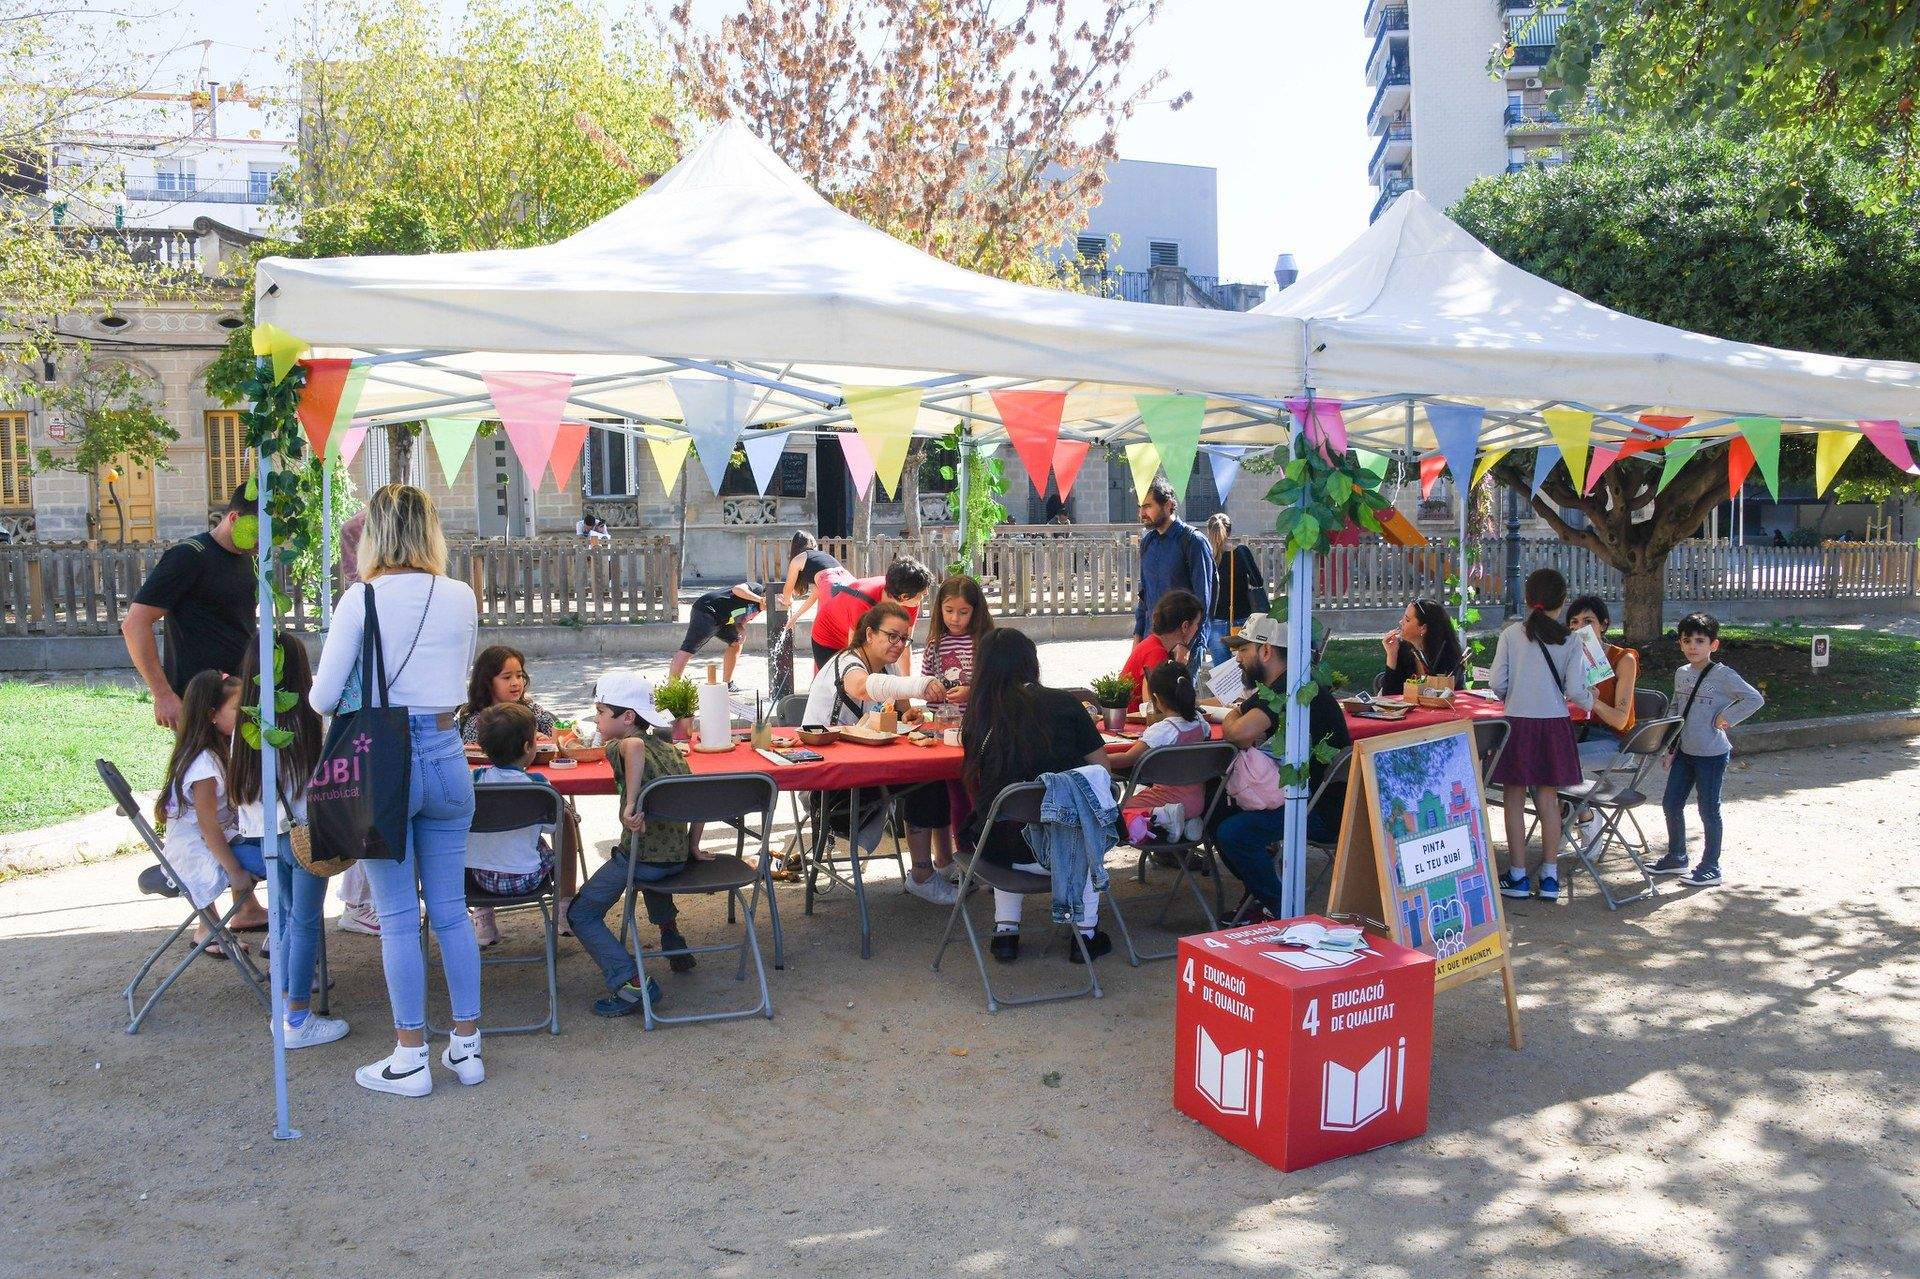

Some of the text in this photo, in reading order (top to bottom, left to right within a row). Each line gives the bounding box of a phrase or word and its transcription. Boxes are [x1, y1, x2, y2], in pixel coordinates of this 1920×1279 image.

[1422, 840, 1445, 855] PINTA
[1415, 849, 1461, 874] EL TEU RUBÍ
[1203, 938, 1229, 948] 4
[1447, 960, 1460, 971] QUE
[1461, 947, 1492, 966] IMAGINEM
[1182, 957, 1246, 997] 4 EDUCACIÓ
[1203, 985, 1255, 1023] DE QUALITAT
[1302, 979, 1385, 1037] 4 EDUCACIÓ
[1331, 1003, 1395, 1032] DE QUALITAT
